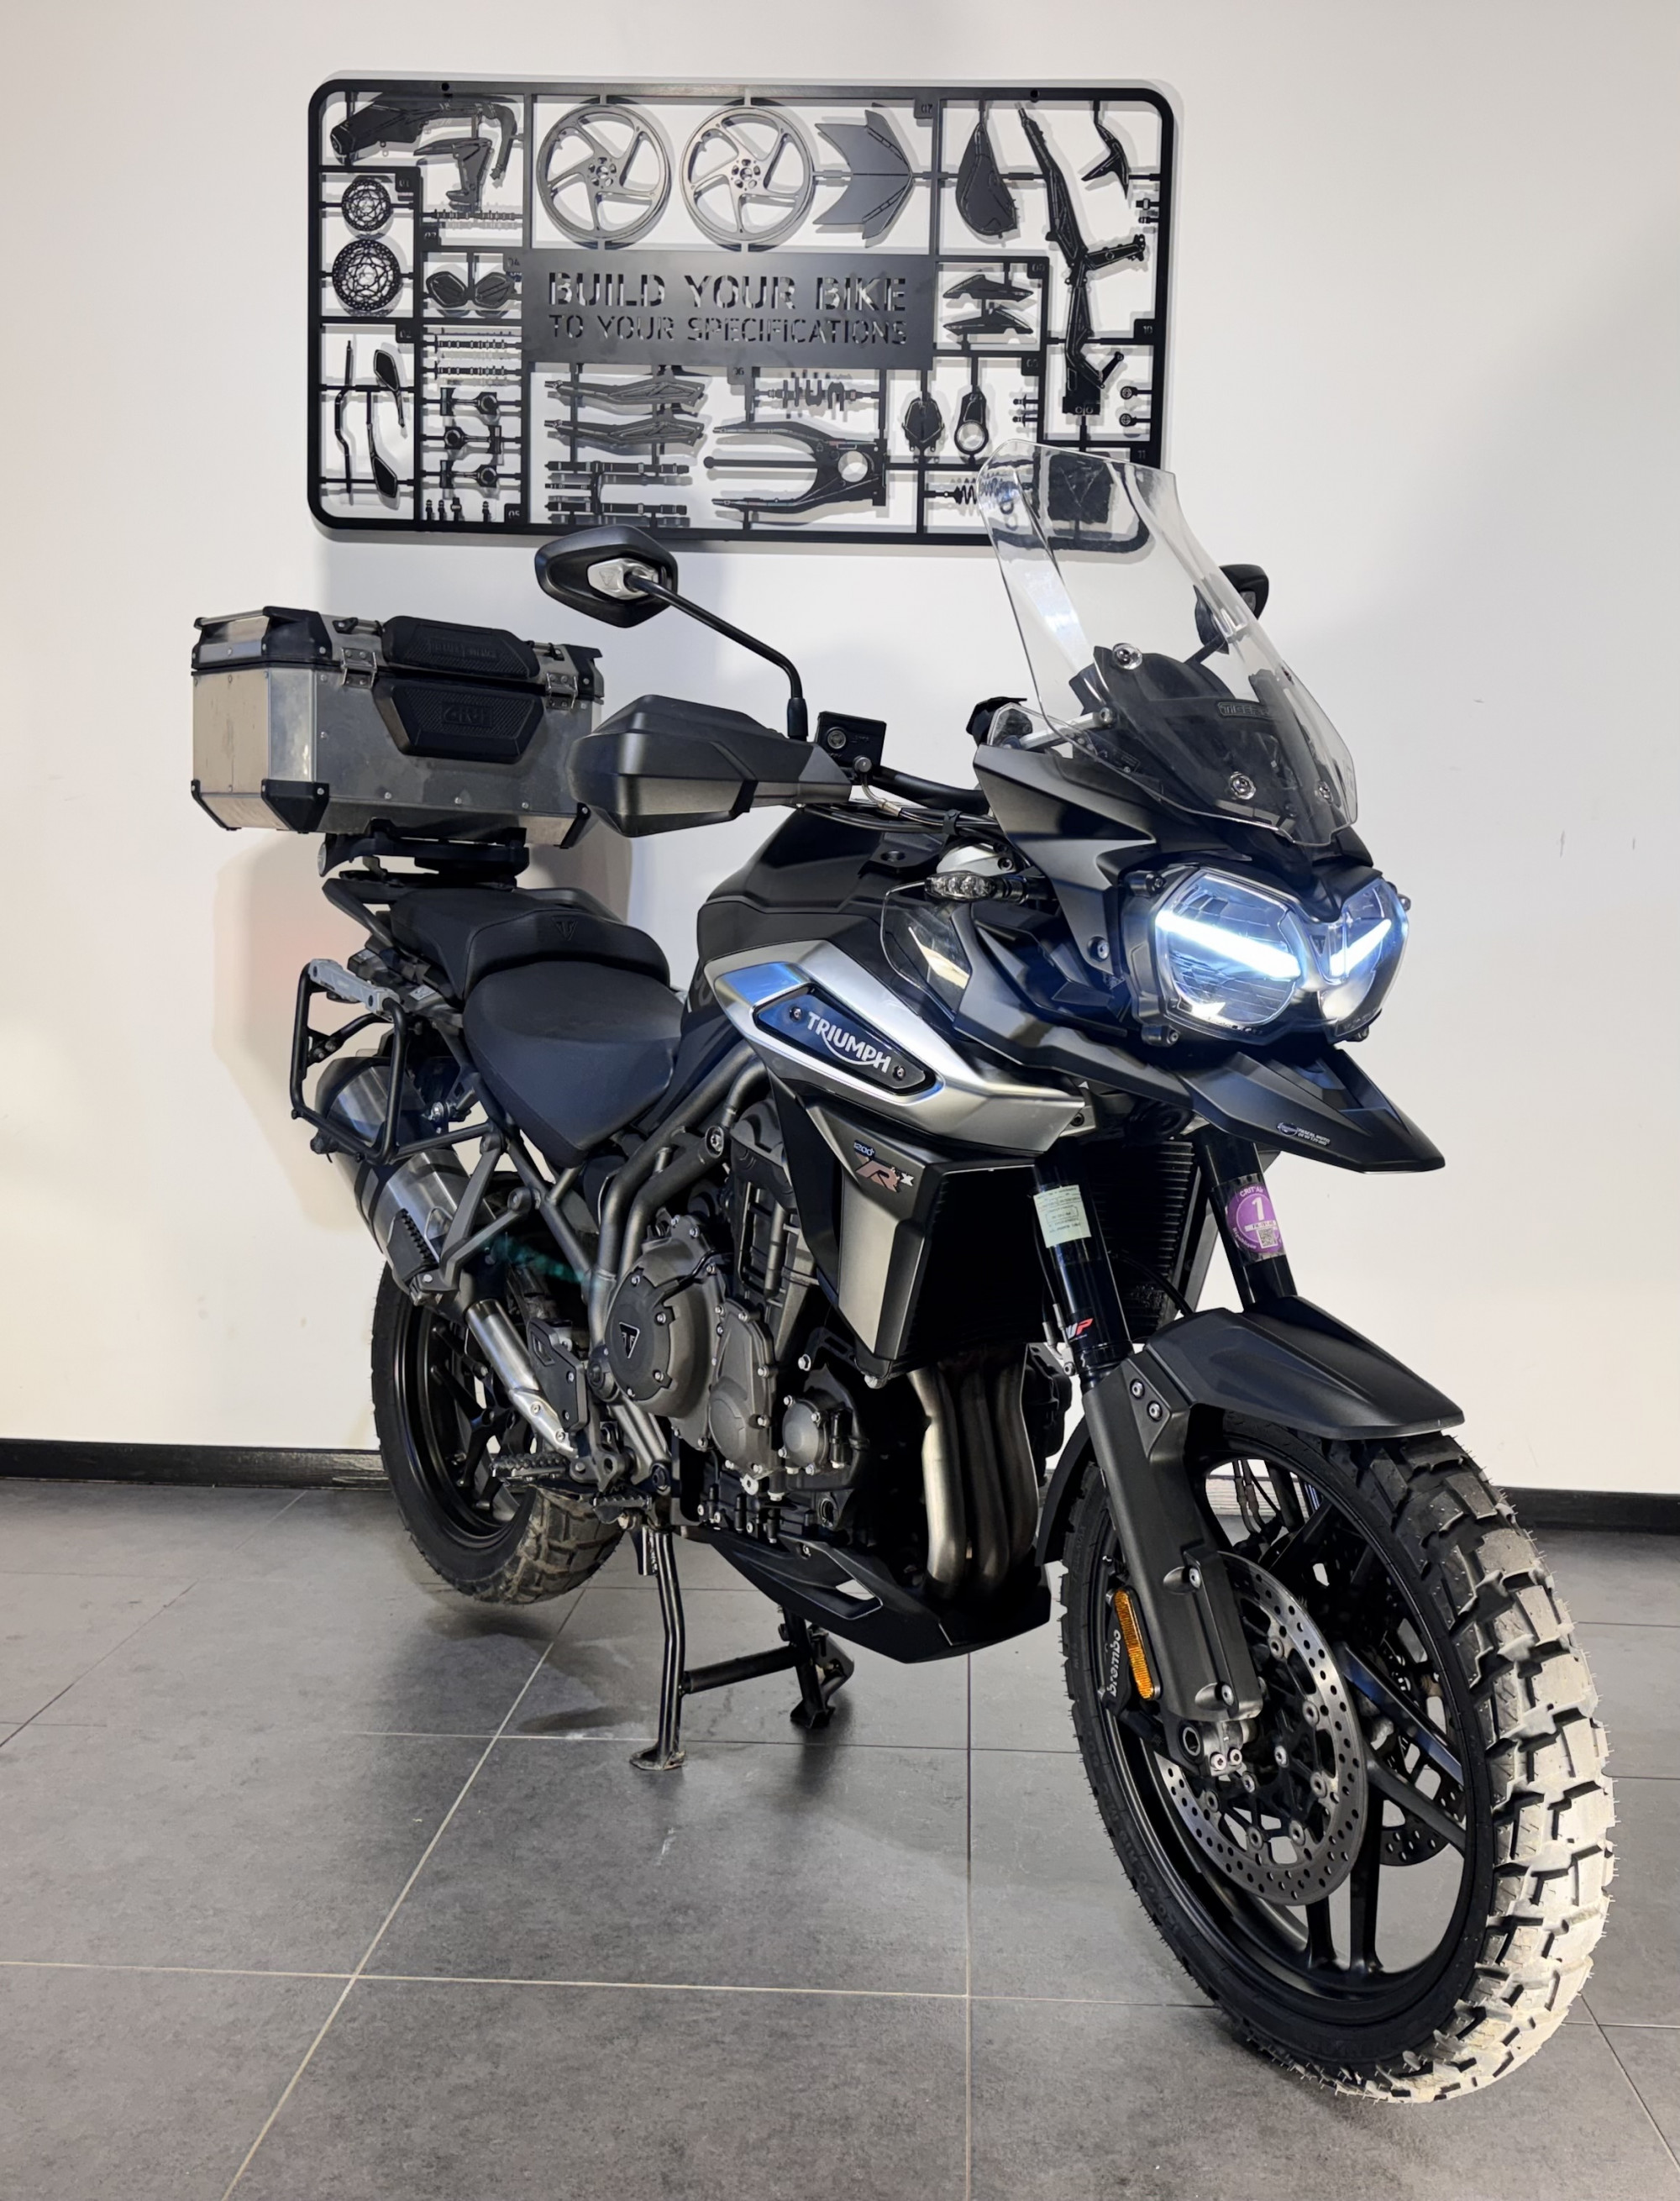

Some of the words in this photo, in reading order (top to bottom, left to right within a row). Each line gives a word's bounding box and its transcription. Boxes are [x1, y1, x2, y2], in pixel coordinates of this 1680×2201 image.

[549, 272, 665, 307] BUILD
[684, 275, 795, 309] YOUR
[816, 276, 906, 311] BIKE
[549, 315, 584, 339] TO
[597, 316, 674, 340] YOUR
[687, 318, 908, 344] SPECIFICATIONS
[807, 1011, 892, 1074] TRIUMPH
[1252, 1196, 1264, 1221] 1
[1106, 1629, 1121, 1698] brembo
